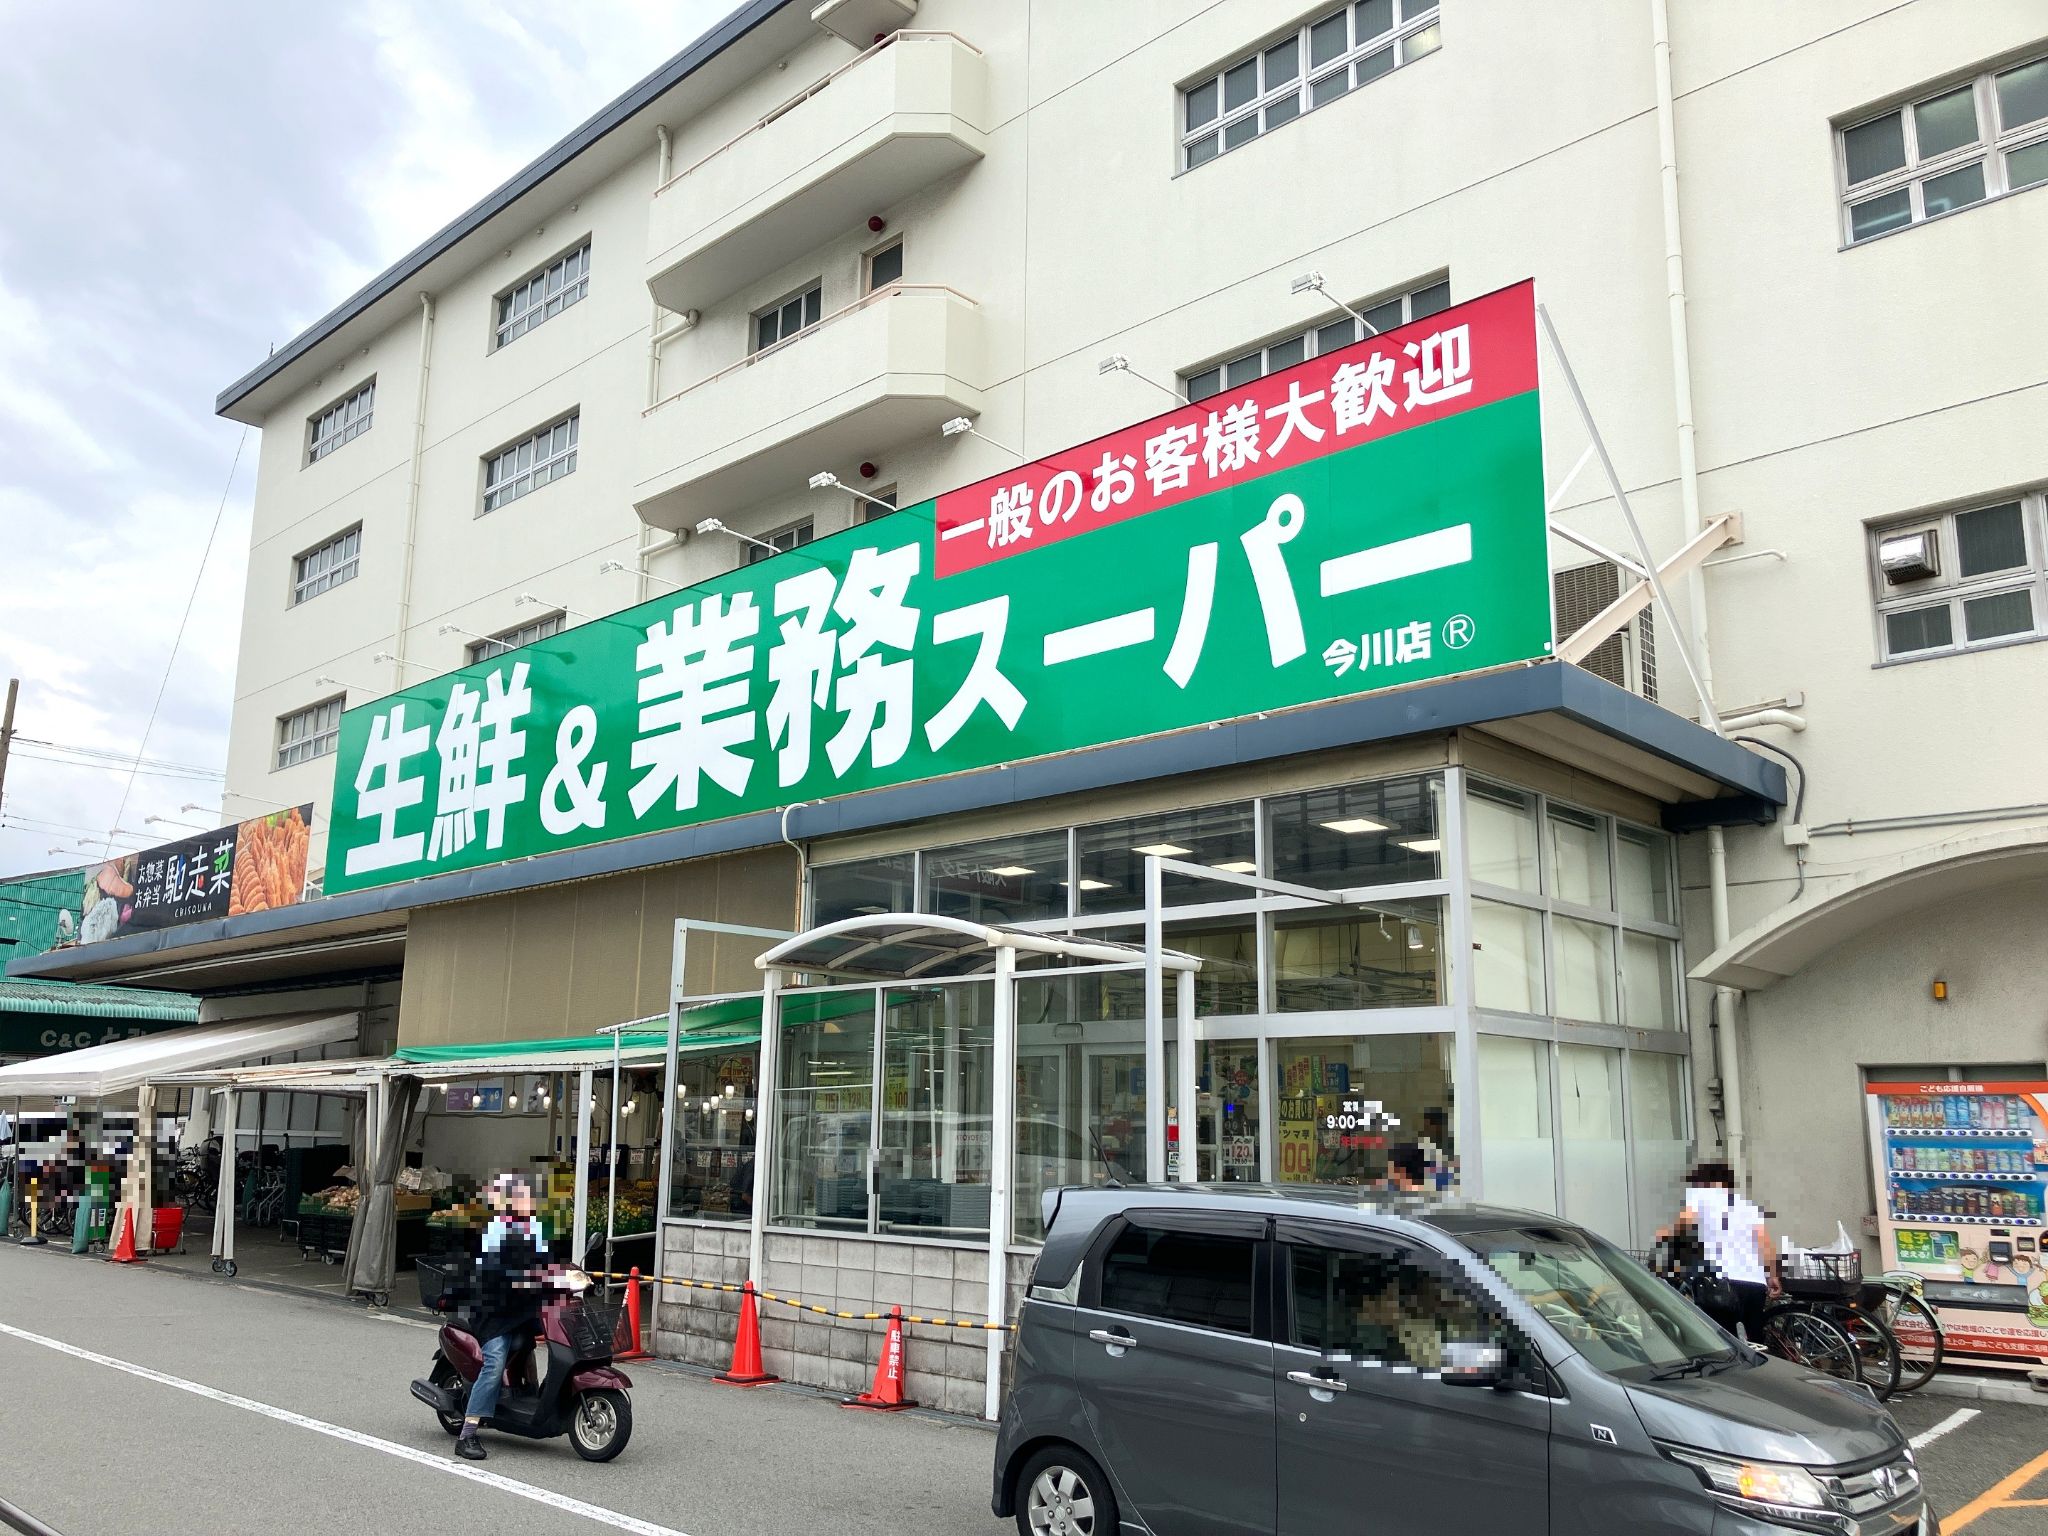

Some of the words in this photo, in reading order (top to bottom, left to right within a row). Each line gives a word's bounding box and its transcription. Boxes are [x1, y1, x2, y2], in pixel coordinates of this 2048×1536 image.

[941, 324, 1473, 549] 一般のお客様大歓迎
[1322, 621, 1431, 678] 今川店
[138, 858, 165, 885] お惣菜
[162, 838, 234, 903] 馳走菜
[135, 881, 160, 909] お弁当
[40, 1029, 92, 1048] C&C
[1897, 1231, 1929, 1244] 電子
